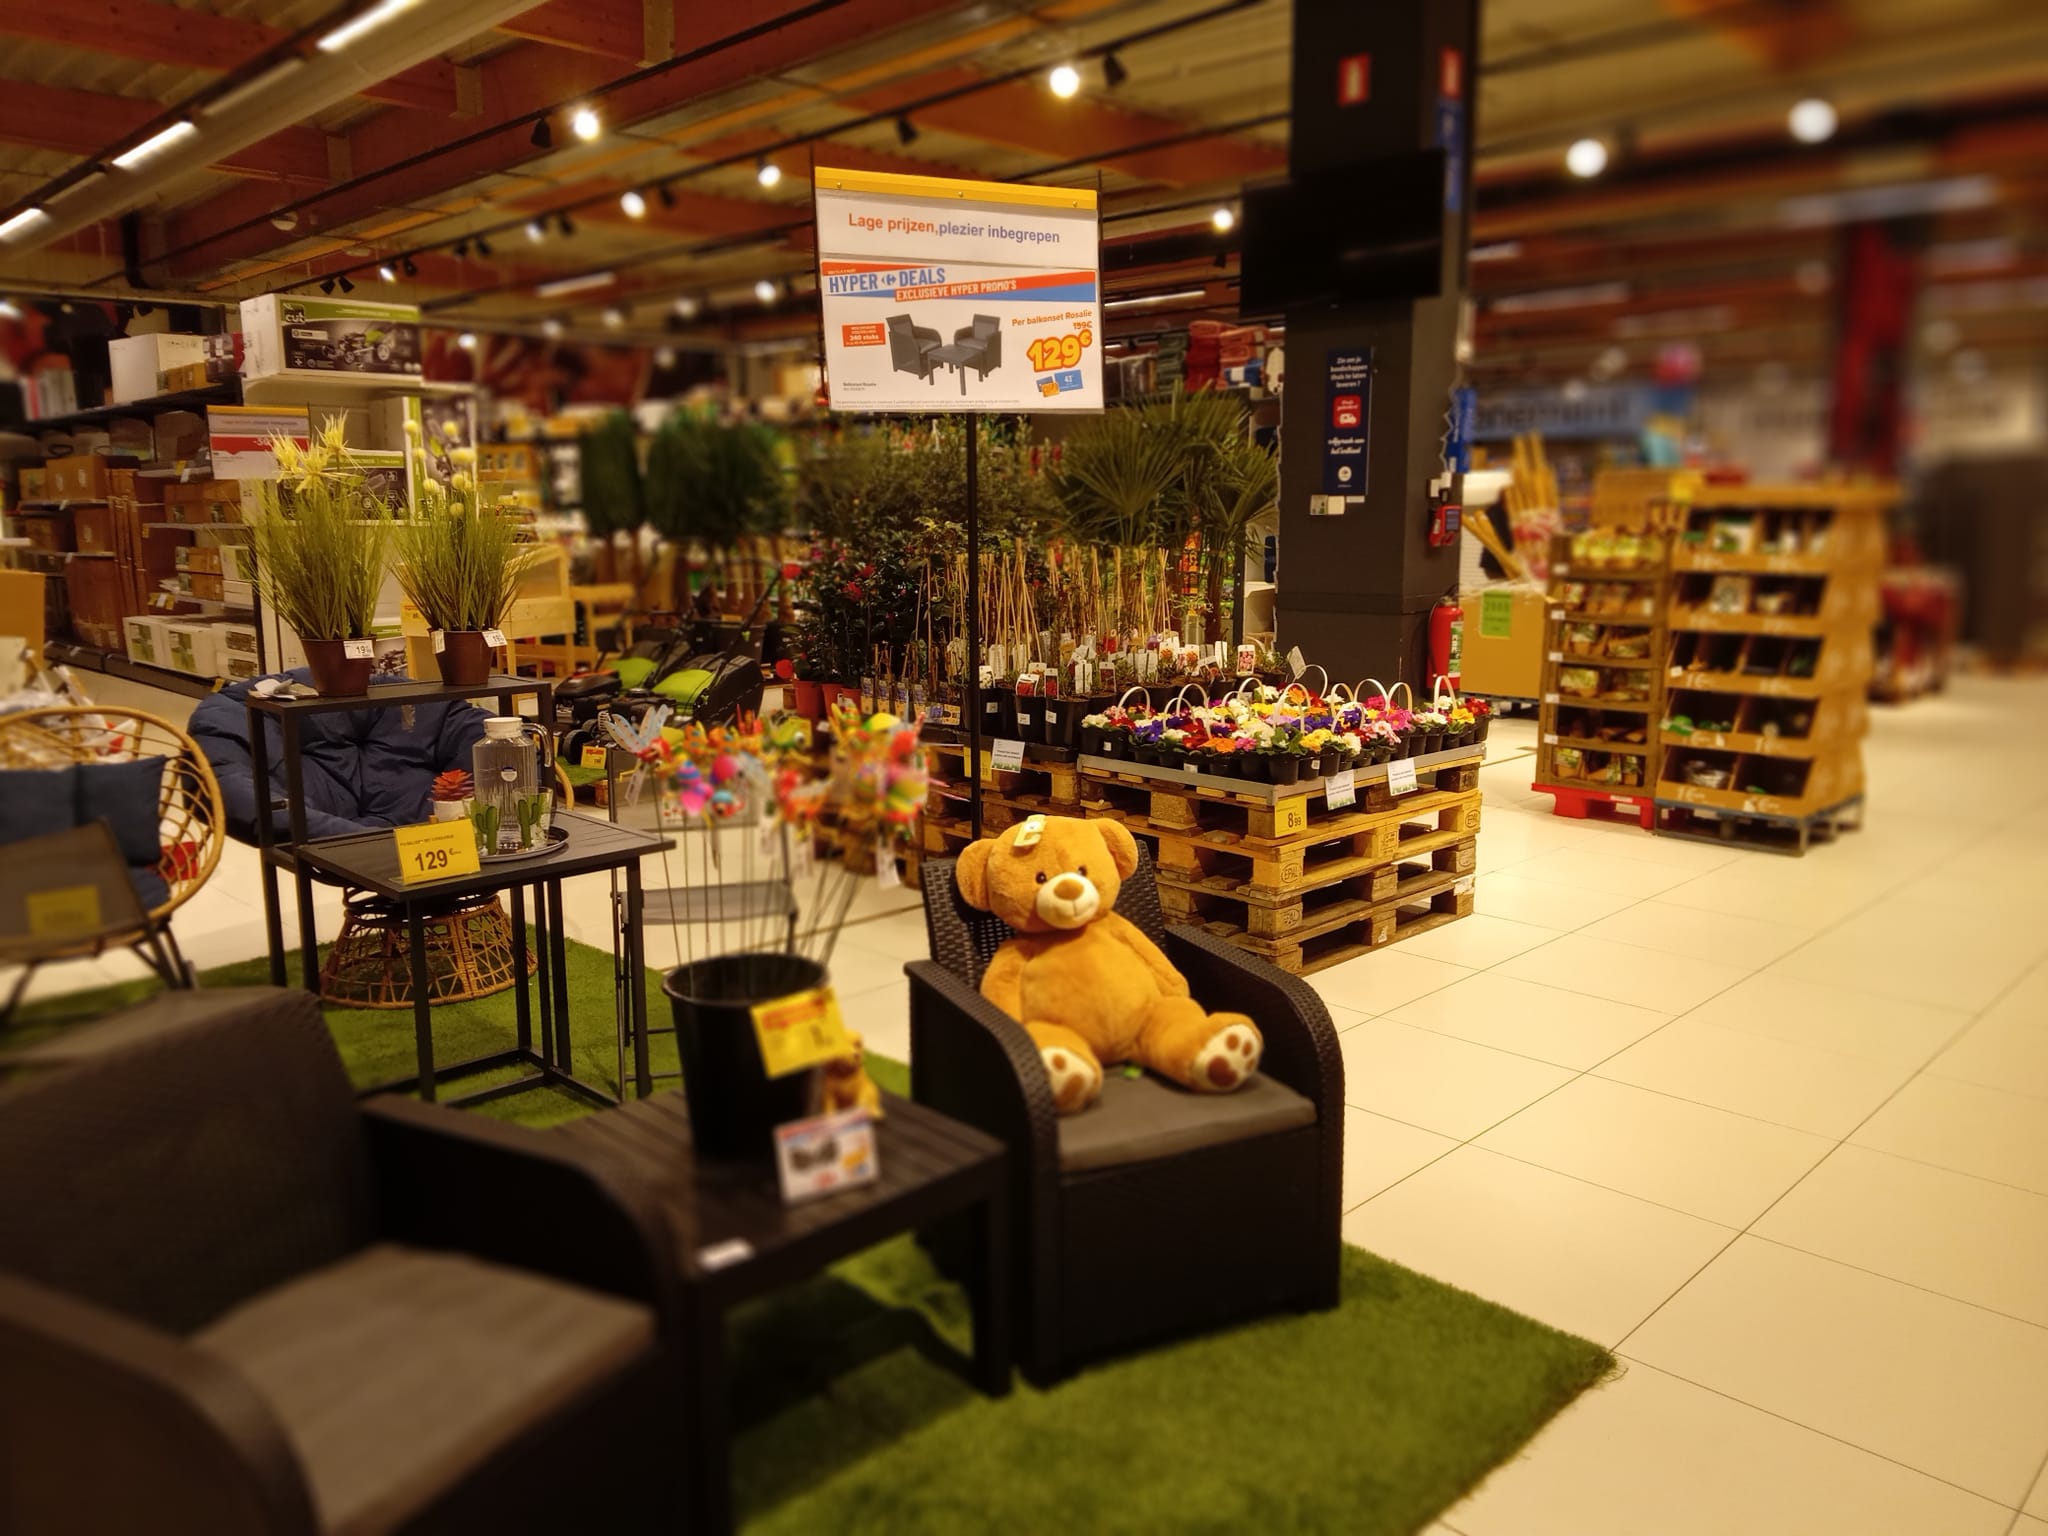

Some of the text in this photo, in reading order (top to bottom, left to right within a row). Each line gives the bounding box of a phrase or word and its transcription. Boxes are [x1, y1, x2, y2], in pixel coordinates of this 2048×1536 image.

[848, 213, 884, 230] Lage
[987, 225, 1060, 244] inbegrepen
[828, 267, 946, 293] HYPER DEALS
[896, 280, 1017, 302] EXCLUSIEVE HYPER PROMO'S
[286, 311, 305, 323] cut
[1012, 318, 1026, 327] Per
[1065, 309, 1093, 319] Rosalie
